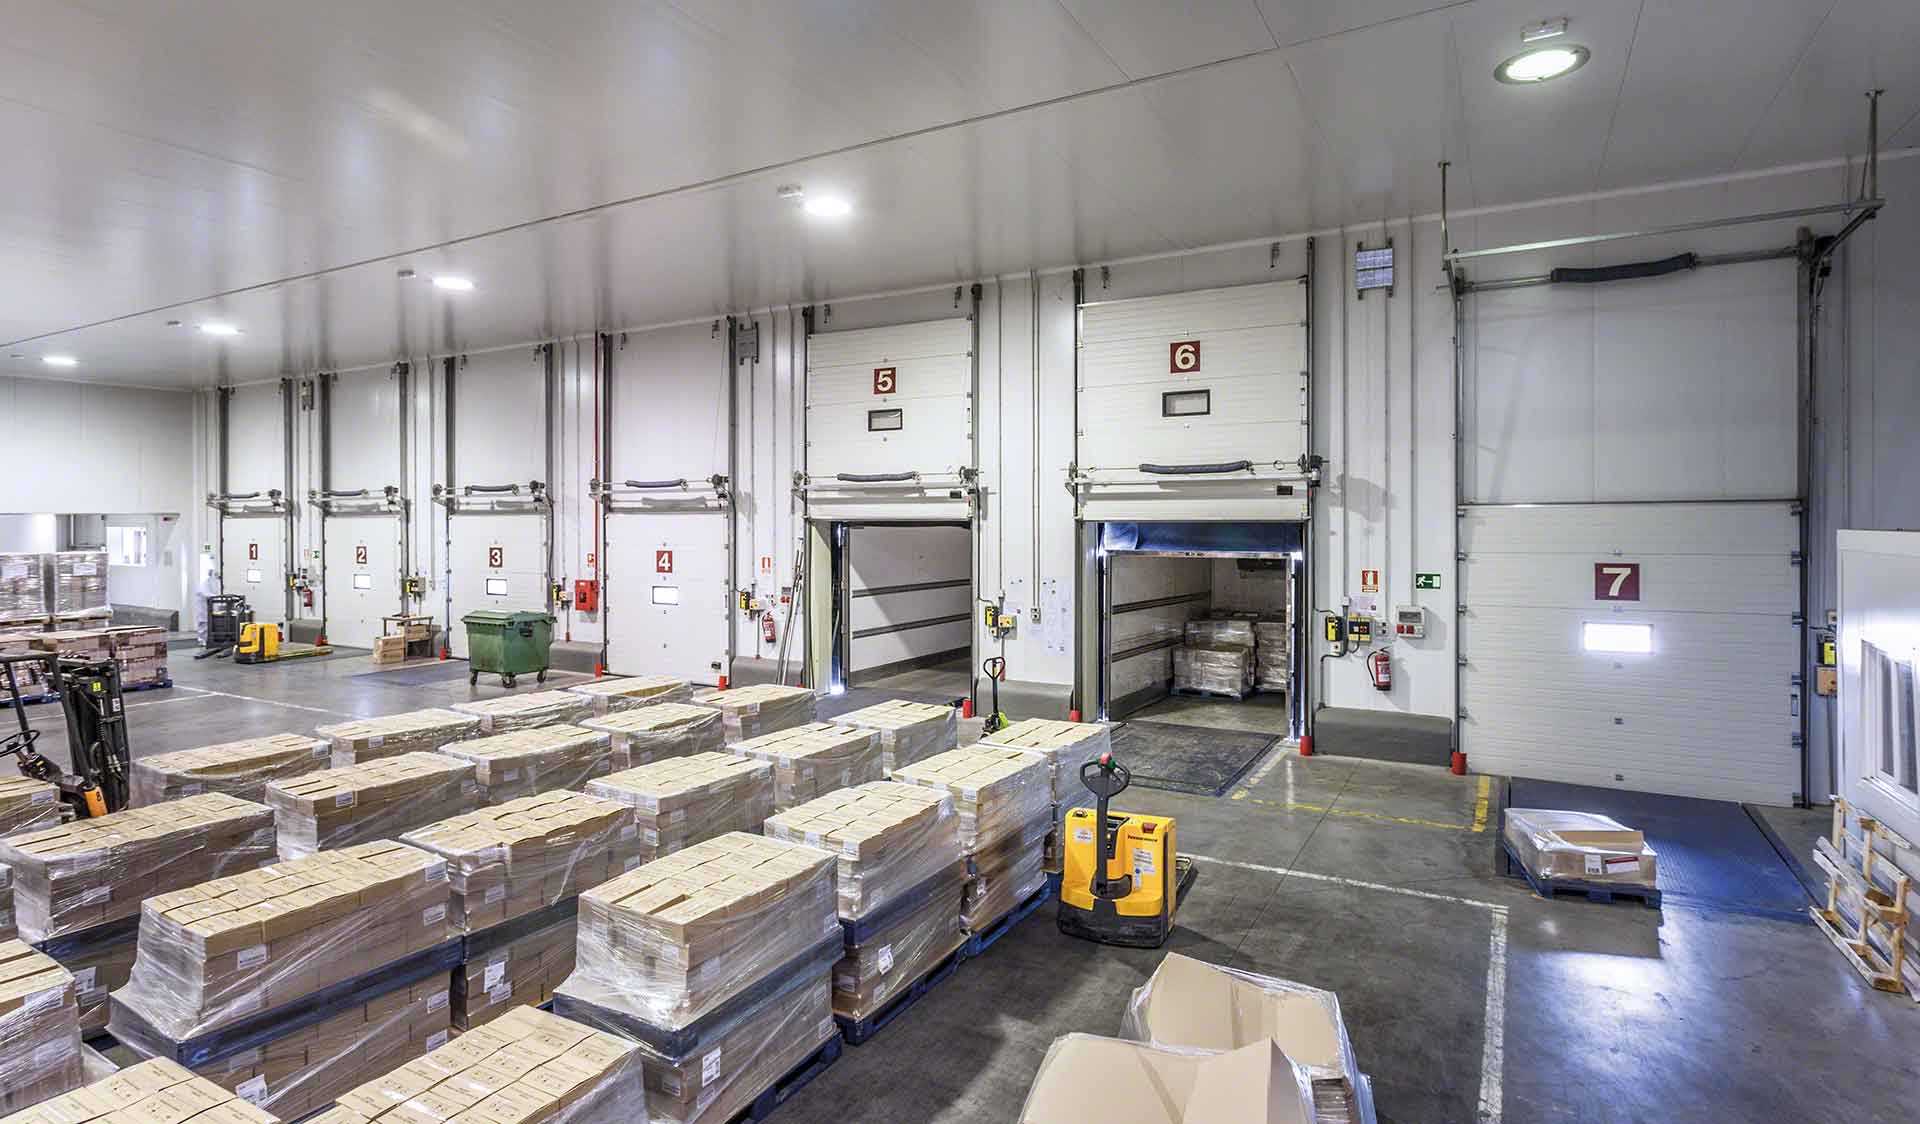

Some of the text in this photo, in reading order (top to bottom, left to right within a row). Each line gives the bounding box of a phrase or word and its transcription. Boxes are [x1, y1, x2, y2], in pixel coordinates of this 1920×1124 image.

[1175, 345, 1195, 369] 6
[878, 370, 892, 391] 5
[251, 545, 257, 559] 1
[358, 547, 366, 563] 2
[492, 549, 501, 565] 3
[659, 553, 670, 571] 4
[1603, 568, 1631, 596] 7
